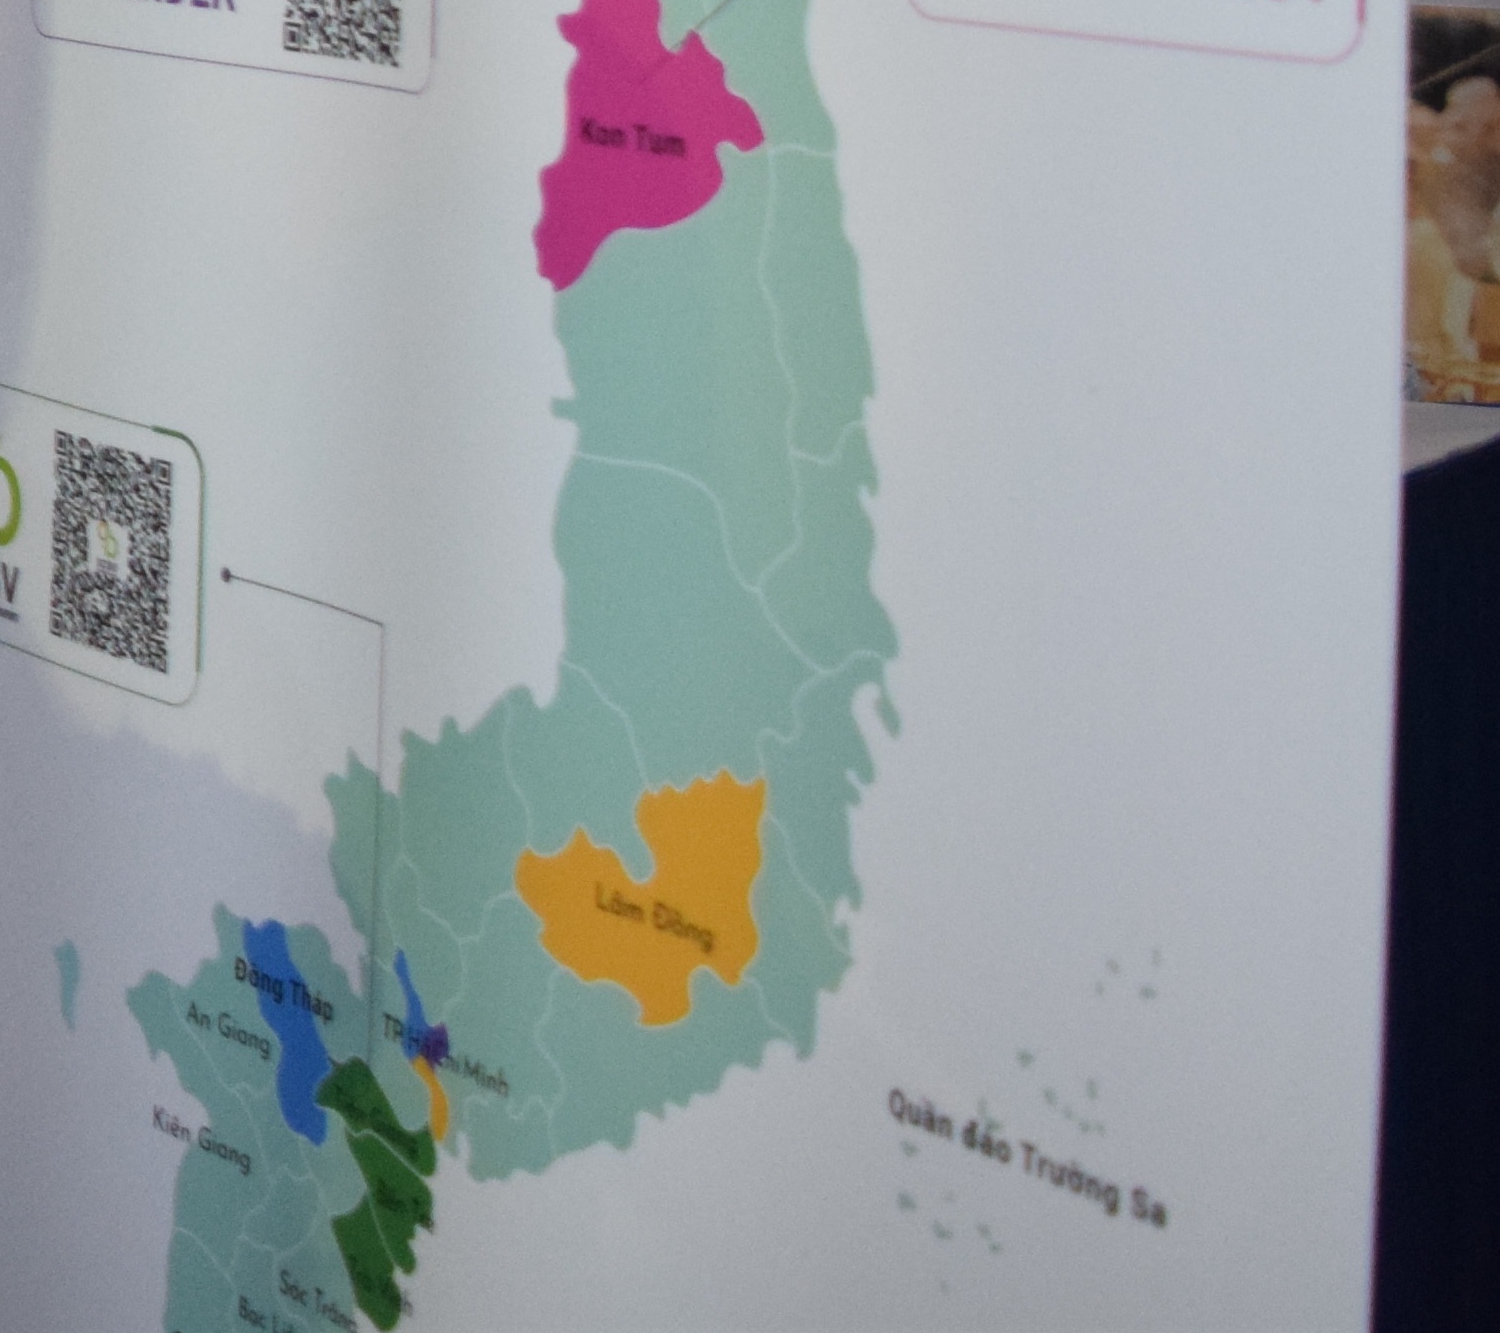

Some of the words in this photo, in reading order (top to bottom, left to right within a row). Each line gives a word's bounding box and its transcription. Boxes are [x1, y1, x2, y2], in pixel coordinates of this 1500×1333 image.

[185, 1000, 211, 1030] An
[218, 1012, 270, 1061] Giang
[152, 1104, 191, 1144] Kiên
[198, 1132, 253, 1177] Giang
[1131, 1185, 1168, 1229] Sa
